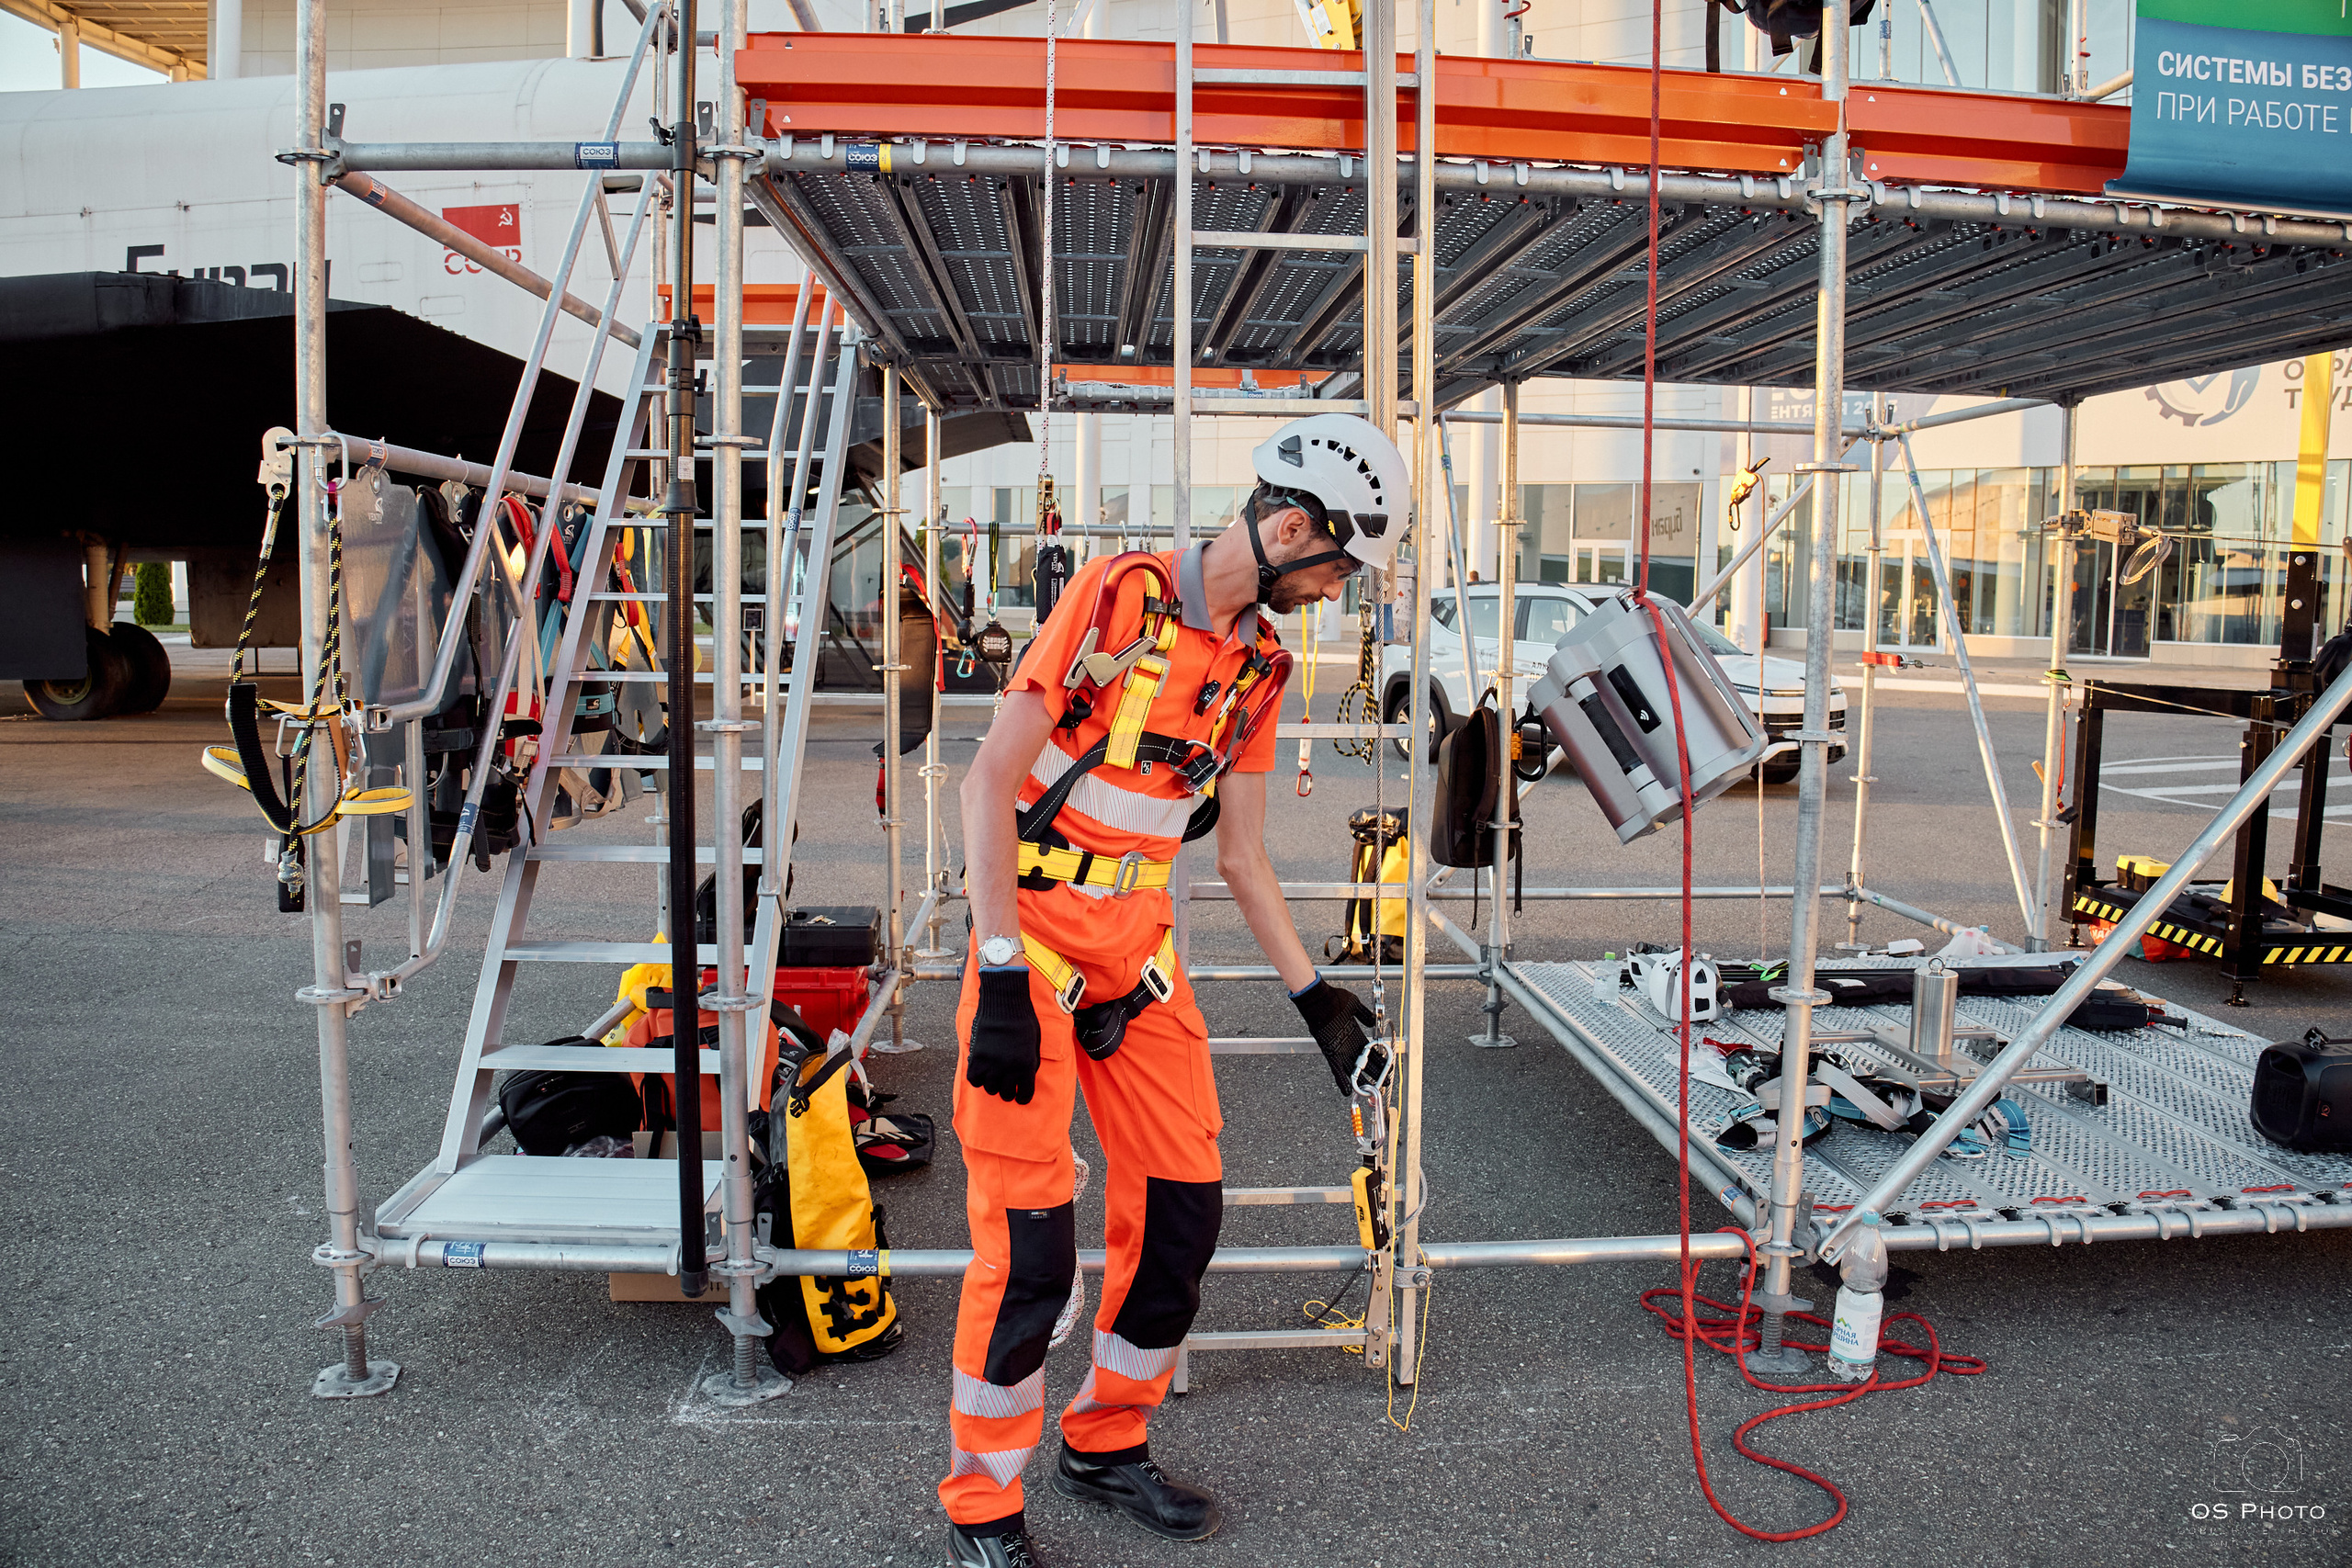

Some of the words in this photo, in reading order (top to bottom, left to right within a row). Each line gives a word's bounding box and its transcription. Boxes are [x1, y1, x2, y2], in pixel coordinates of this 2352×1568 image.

[2157, 51, 2292, 87] СИСТЕМЫ
[2301, 64, 2352, 92] БЕЗ
[2156, 91, 2216, 124] ПРИ
[2228, 98, 2339, 134] РАБОТЕ
[848, 152, 878, 162] СОЮЗ
[449, 1257, 476, 1265] СОЮЗ
[1832, 1331, 1859, 1347] РШИНА
